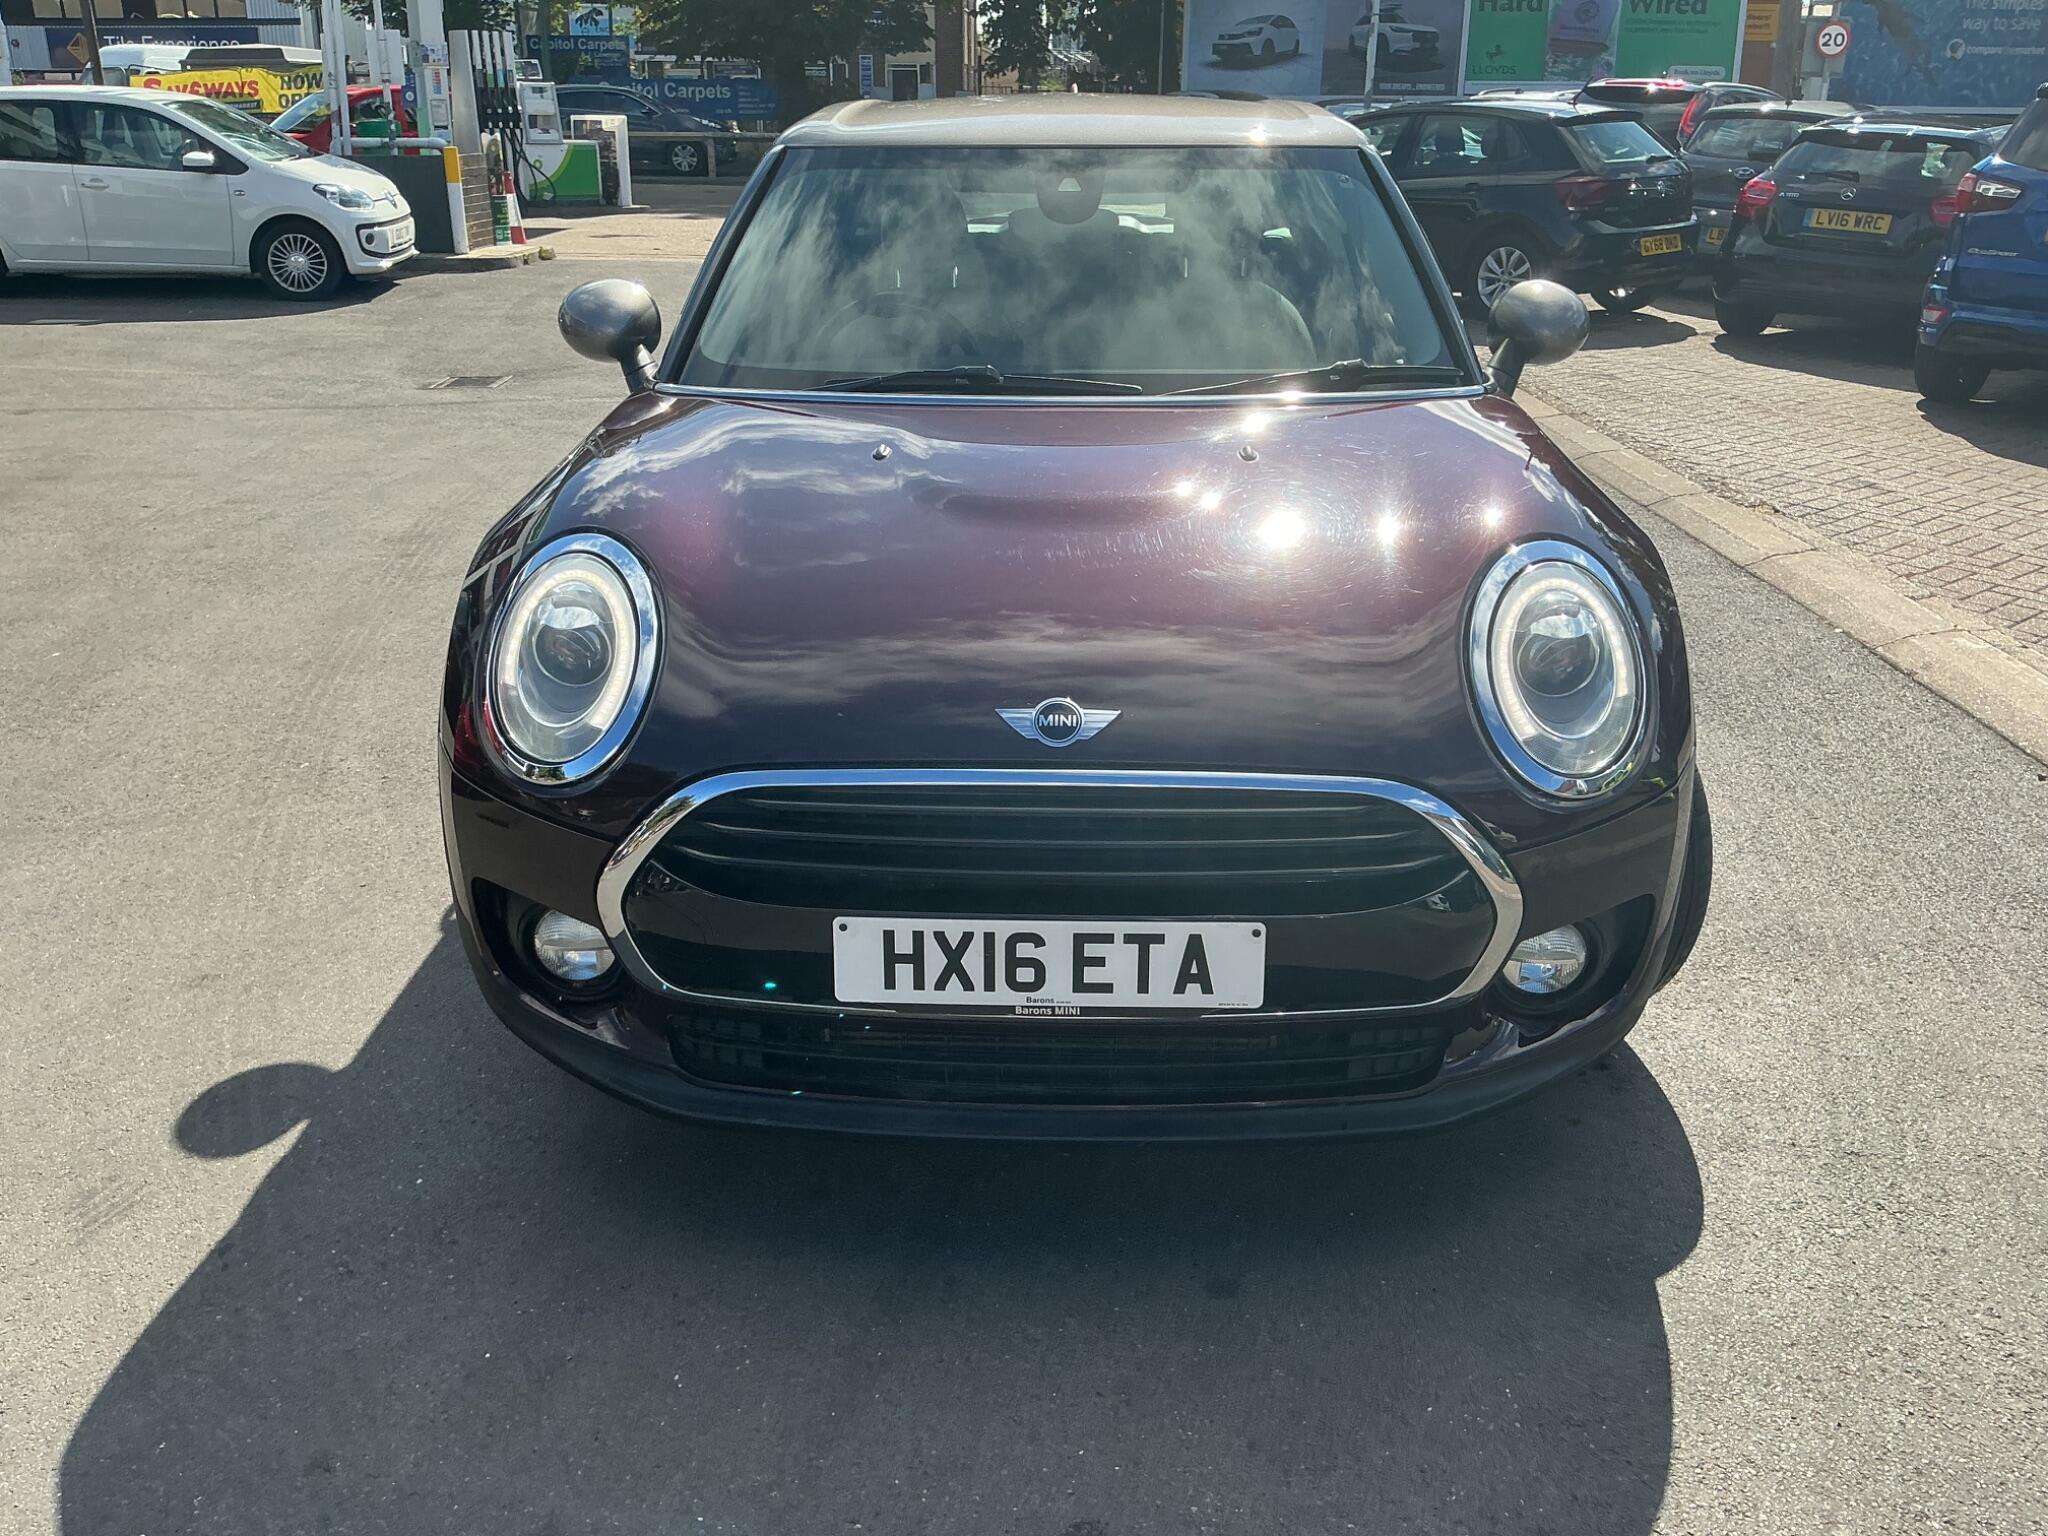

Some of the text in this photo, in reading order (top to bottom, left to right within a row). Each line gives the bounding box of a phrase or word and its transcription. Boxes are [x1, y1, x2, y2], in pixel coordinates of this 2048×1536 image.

[1479, 0, 1543, 12] Hard
[1629, 0, 1707, 14] Wired
[1962, 17, 2041, 33] way to save
[577, 38, 626, 51] Carpets
[1822, 32, 1845, 47] 20
[280, 72, 323, 90] NOW
[664, 82, 732, 102] Carpets
[1815, 210, 1885, 230] LV16 WRC
[1038, 714, 1077, 728] MINI
[882, 929, 1214, 996] HX16 ETA
[1026, 996, 1055, 1004] Barons
[1015, 1006, 1080, 1015] Barons MINI
